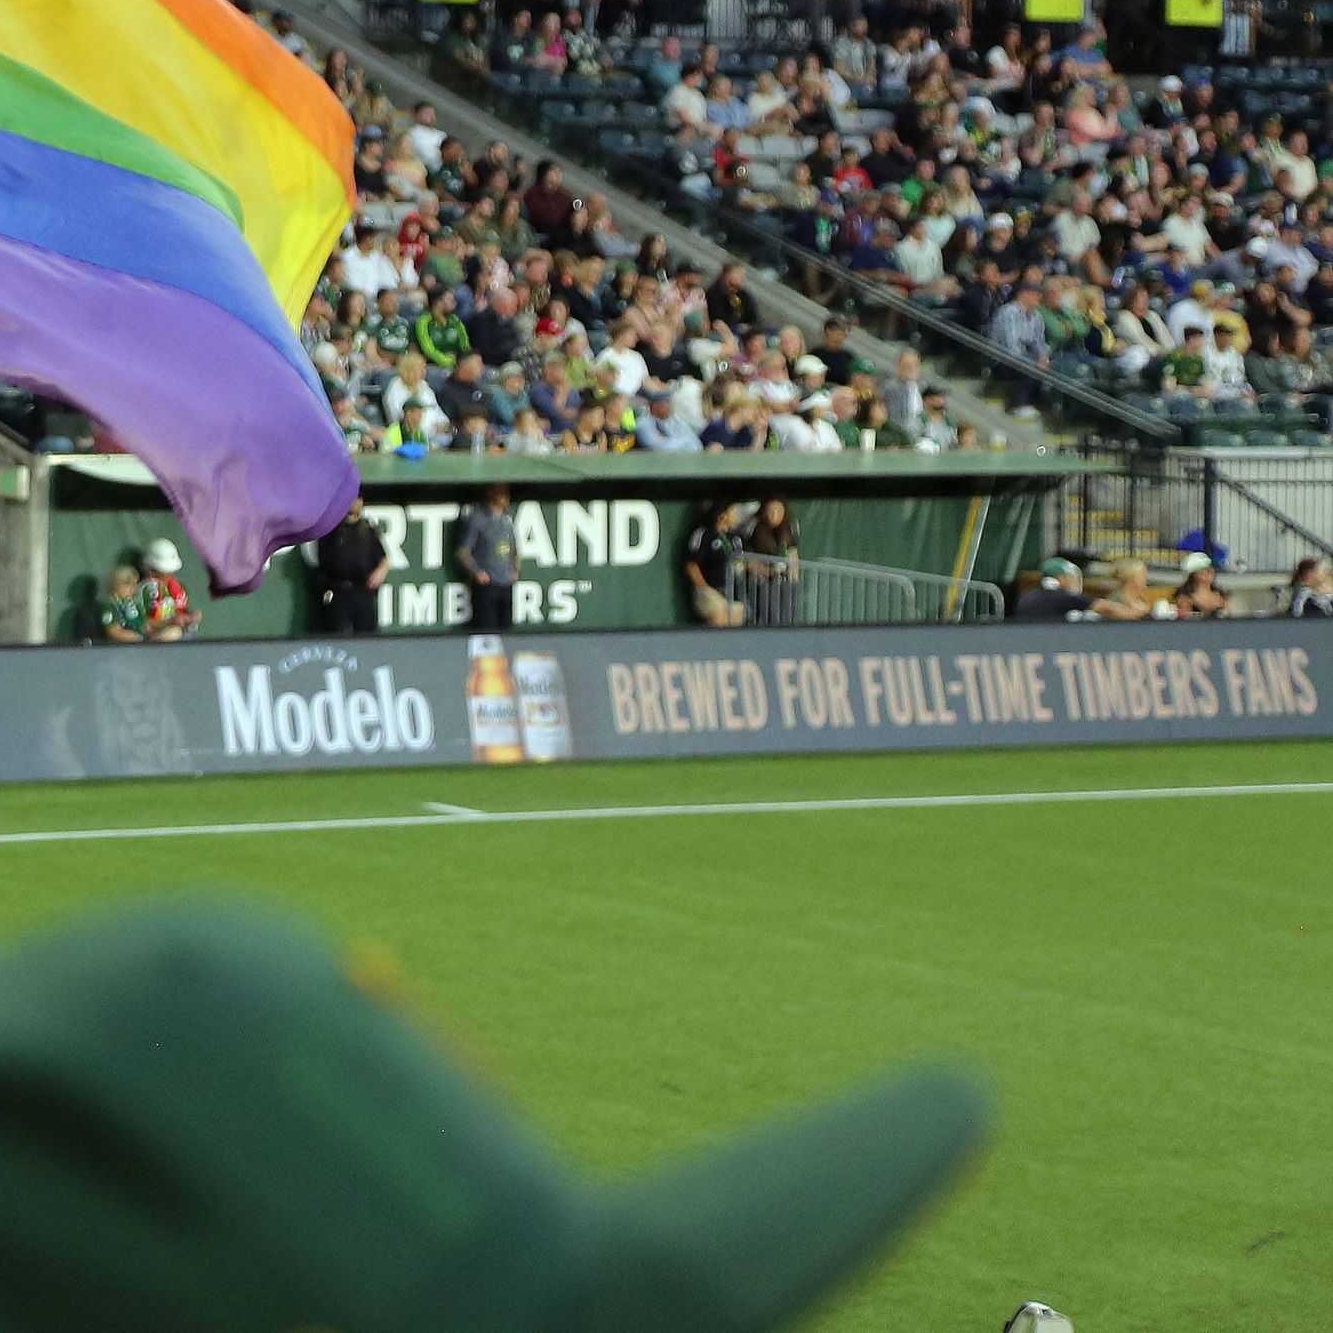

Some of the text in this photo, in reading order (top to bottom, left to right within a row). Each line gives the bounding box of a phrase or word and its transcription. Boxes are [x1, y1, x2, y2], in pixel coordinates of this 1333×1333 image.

[376, 579, 580, 628] IMBRS
[214, 665, 435, 757] Modelo
[607, 646, 1319, 735] BREWED FOR FULL-TIME TIMBERS FANS
